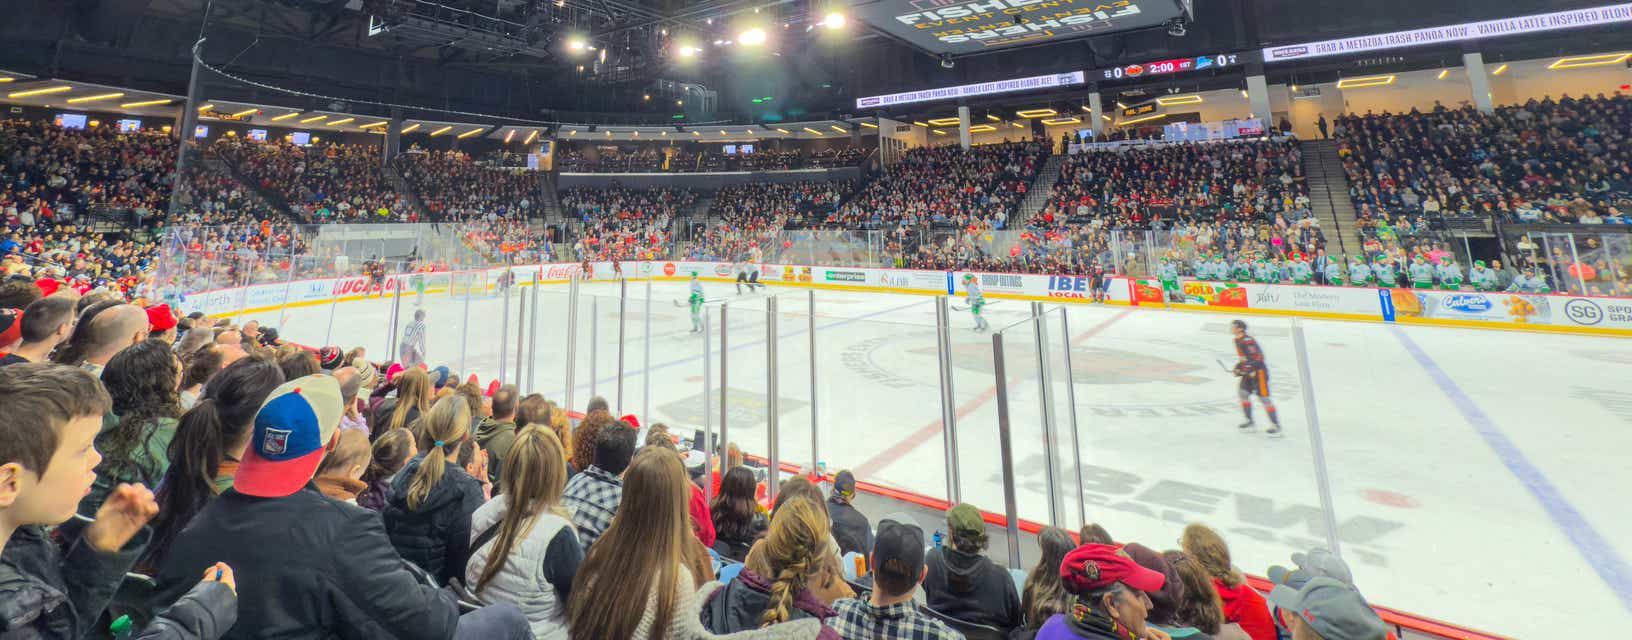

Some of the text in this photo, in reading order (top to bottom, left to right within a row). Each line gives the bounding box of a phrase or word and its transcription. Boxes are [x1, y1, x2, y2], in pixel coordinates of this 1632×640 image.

[914, 12, 994, 29] EVENT
[1040, 0, 1131, 21] EVENT
[938, 3, 1142, 43] FISHERS
[1316, 42, 1338, 55] GRAB
[1346, 35, 1382, 51] METAZOA
[1384, 32, 1412, 47] TRASH
[1414, 28, 1444, 44] PANDA
[1445, 26, 1469, 39] NOW
[1478, 20, 1515, 36] VANILLA
[1518, 16, 1549, 31] LATTE
[1550, 9, 1598, 28] INSPIRED
[1114, 67, 1122, 78] 0
[1150, 62, 1174, 73] 2:00
[1217, 55, 1227, 66] 0
[1183, 283, 1214, 296] GOLD
[1571, 305, 1597, 318] SG
